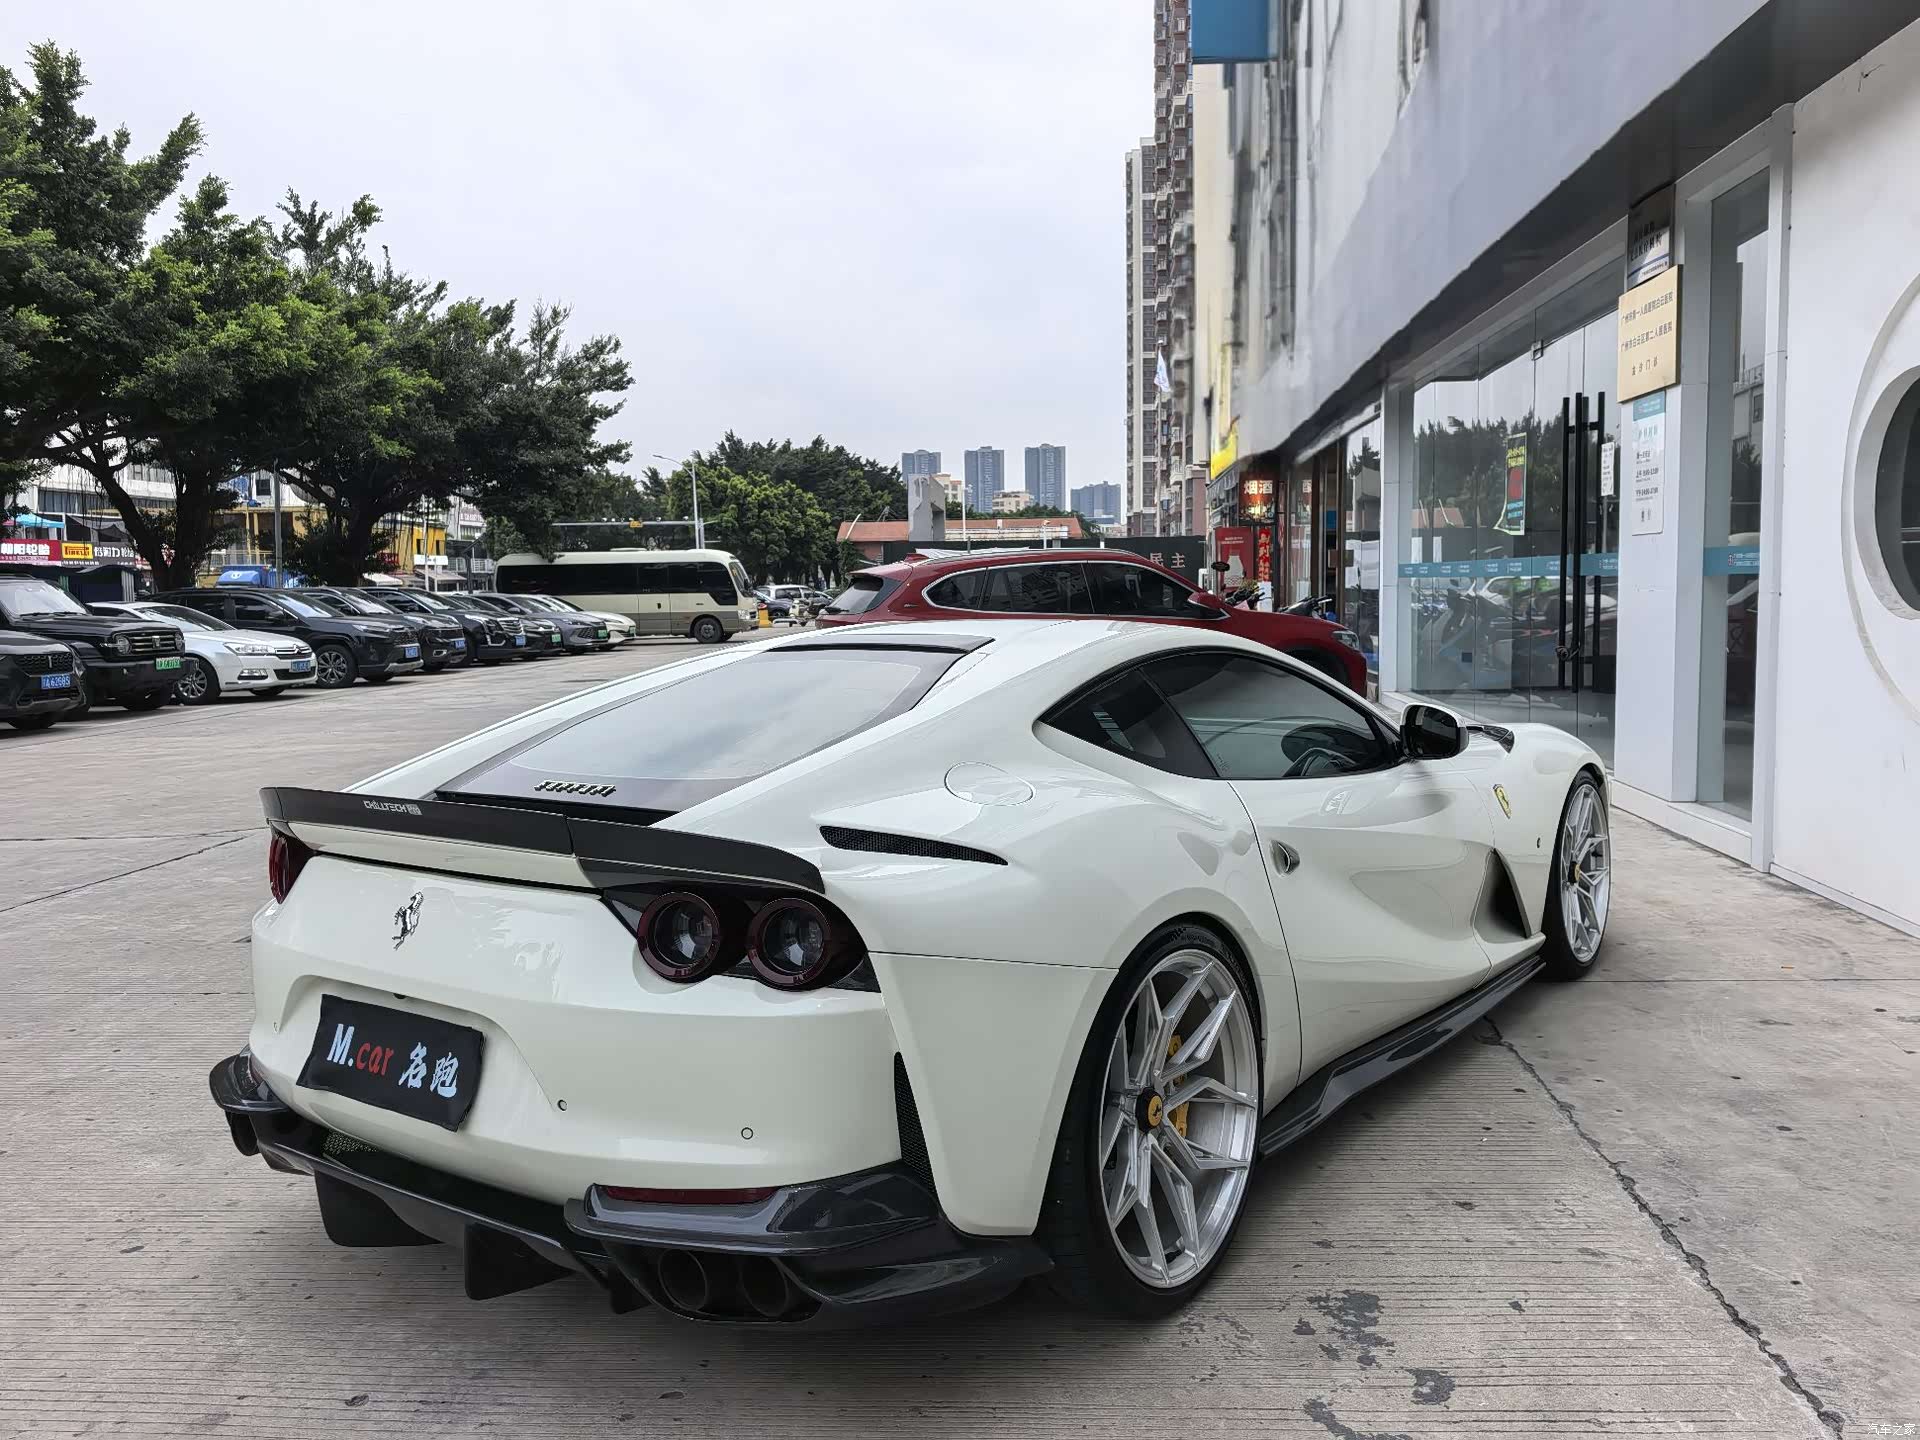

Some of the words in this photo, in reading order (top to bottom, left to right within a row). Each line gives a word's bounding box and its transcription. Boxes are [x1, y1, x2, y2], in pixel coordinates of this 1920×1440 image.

[1243, 479, 1273, 495] 烟酒
[326, 1023, 395, 1077] M.car
[398, 1042, 460, 1099] 名跑
